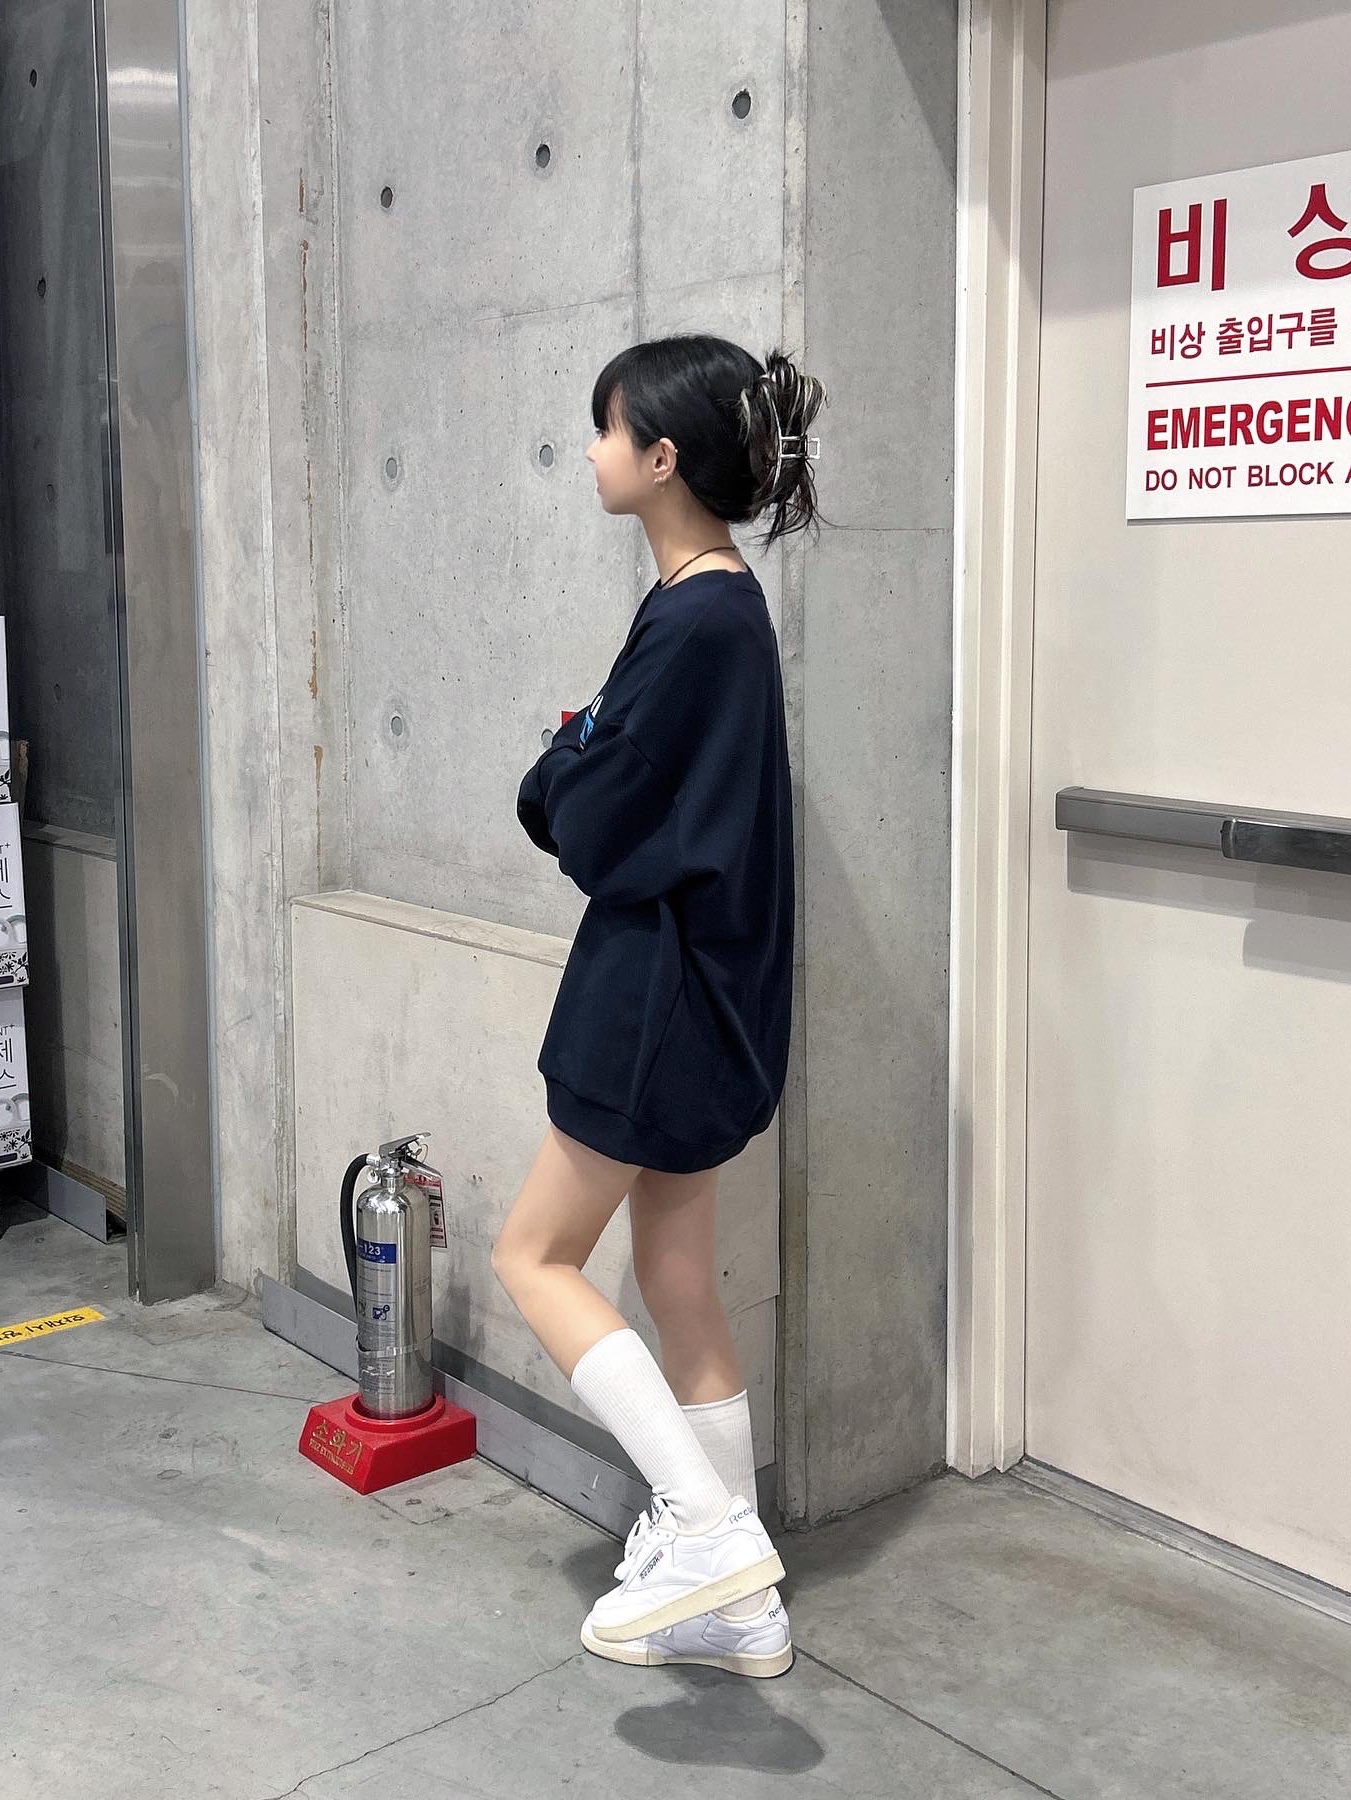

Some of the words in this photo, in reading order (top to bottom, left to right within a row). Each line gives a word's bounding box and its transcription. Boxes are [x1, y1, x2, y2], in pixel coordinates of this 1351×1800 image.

[1151, 321, 1205, 361] 비상
[1217, 307, 1338, 355] 출입구를
[1146, 396, 1351, 451] EMERGEN
[1146, 469, 1178, 491] DO
[1188, 466, 1237, 489] NOT
[1248, 461, 1334, 487] BLOCK
[640, 1556, 660, 1580] Reebok
